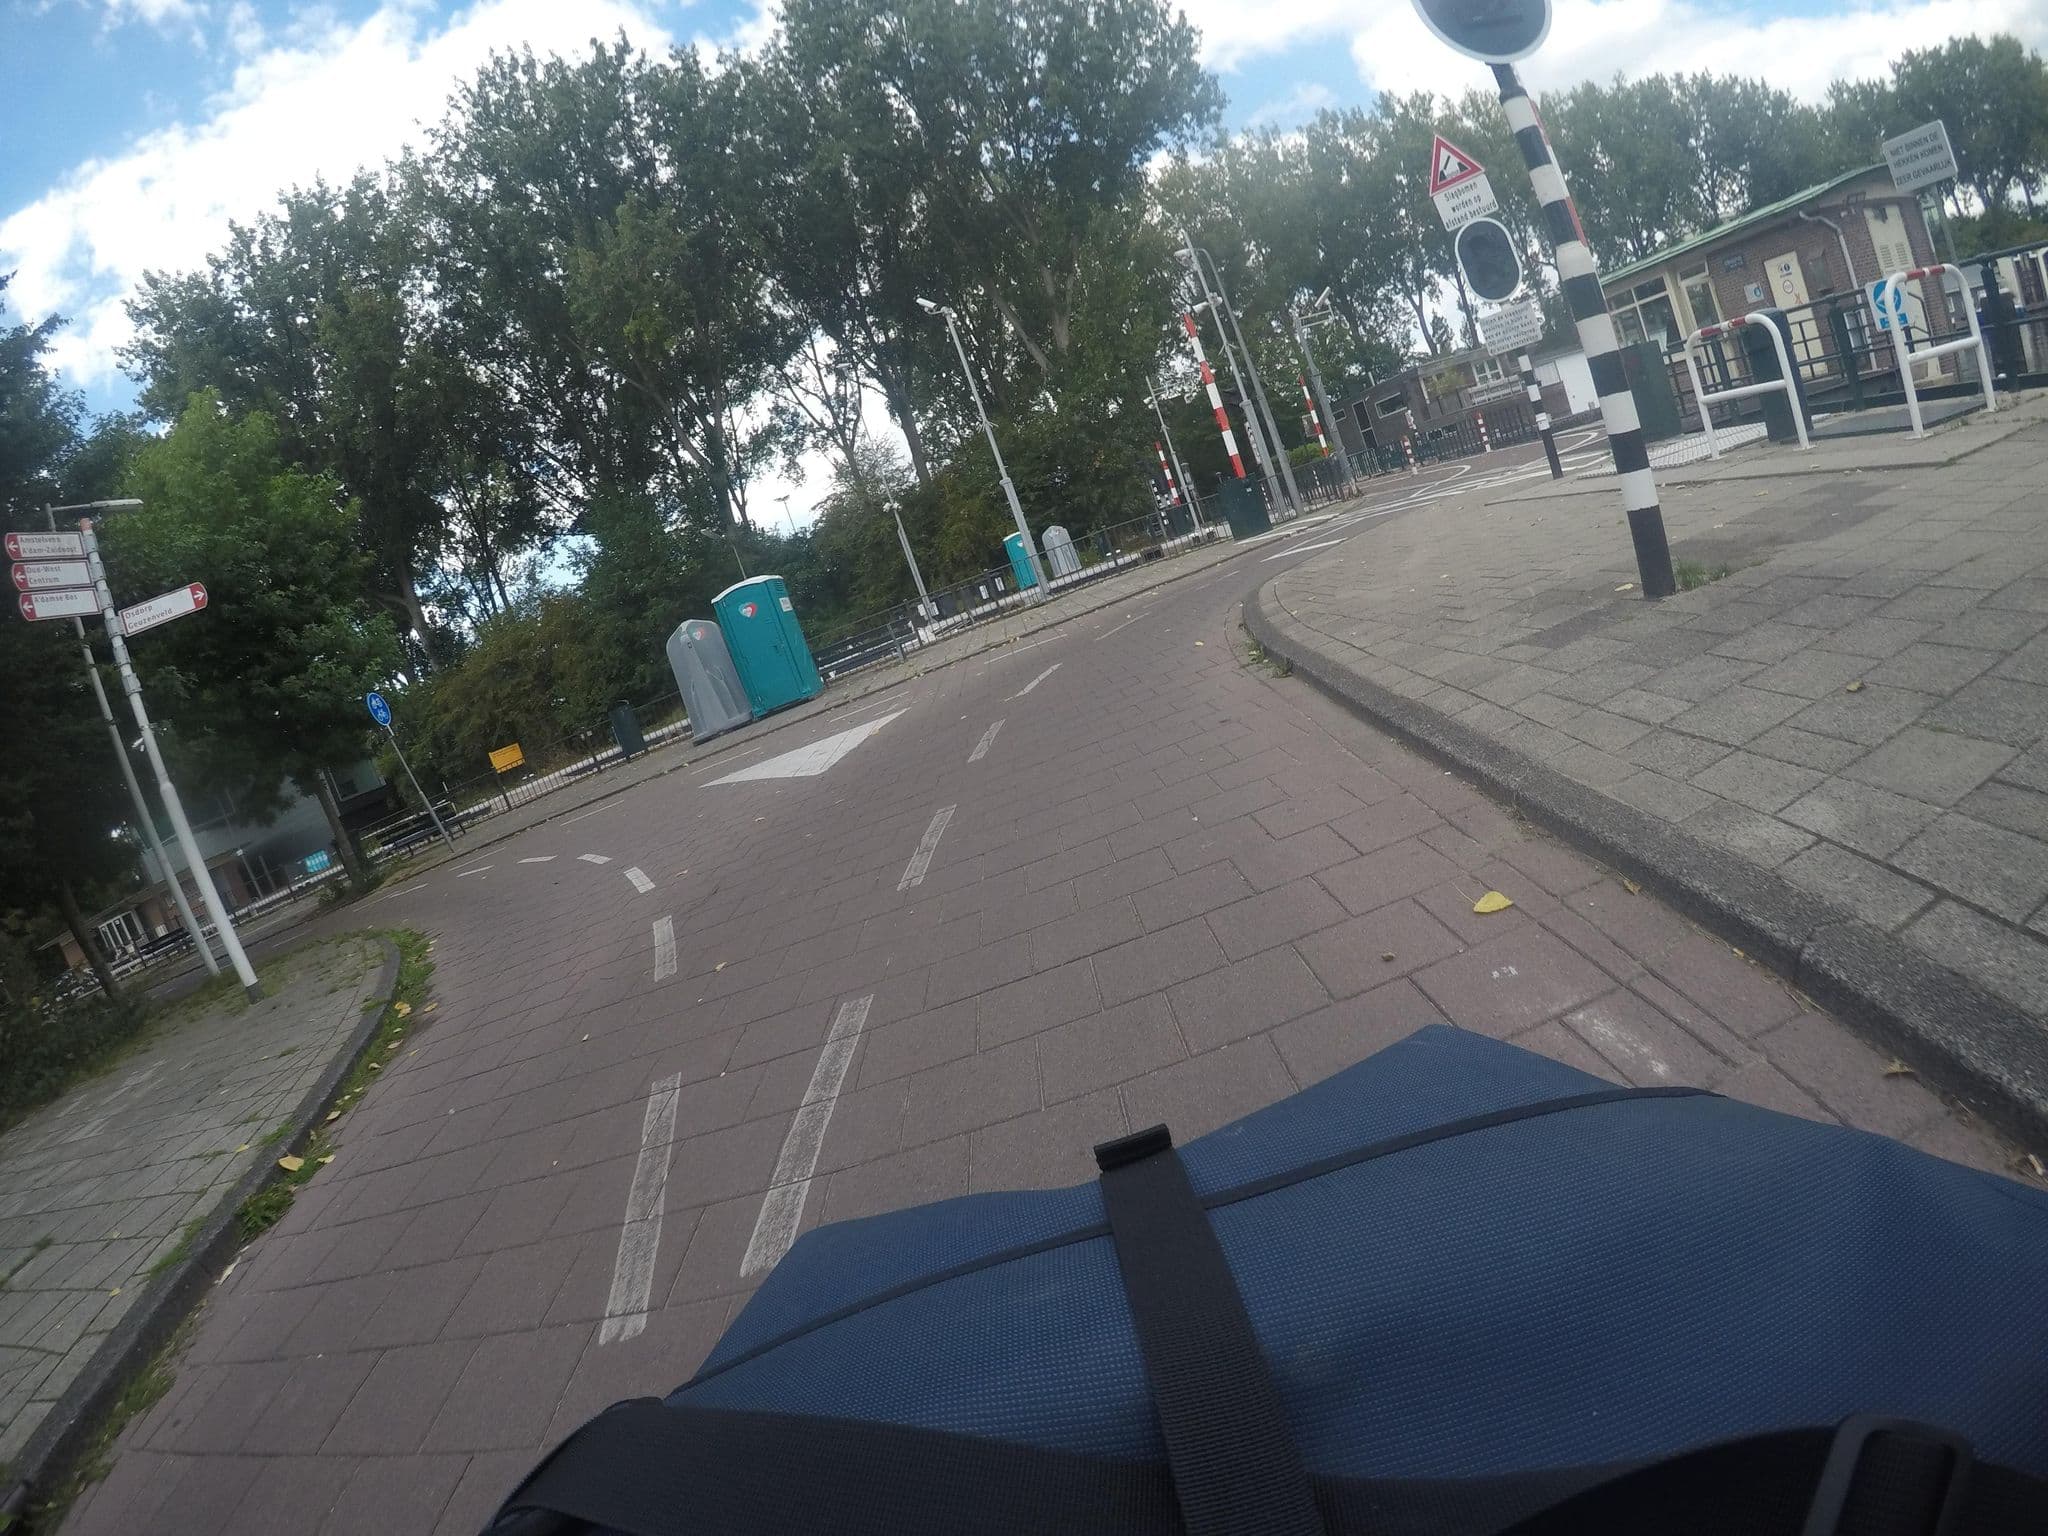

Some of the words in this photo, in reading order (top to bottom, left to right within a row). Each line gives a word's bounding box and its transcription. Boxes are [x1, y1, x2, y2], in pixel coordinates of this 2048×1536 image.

[29, 576, 60, 585] Centrum
[125, 604, 153, 620] Osdorp
[128, 608, 173, 630] Geuzenveld
